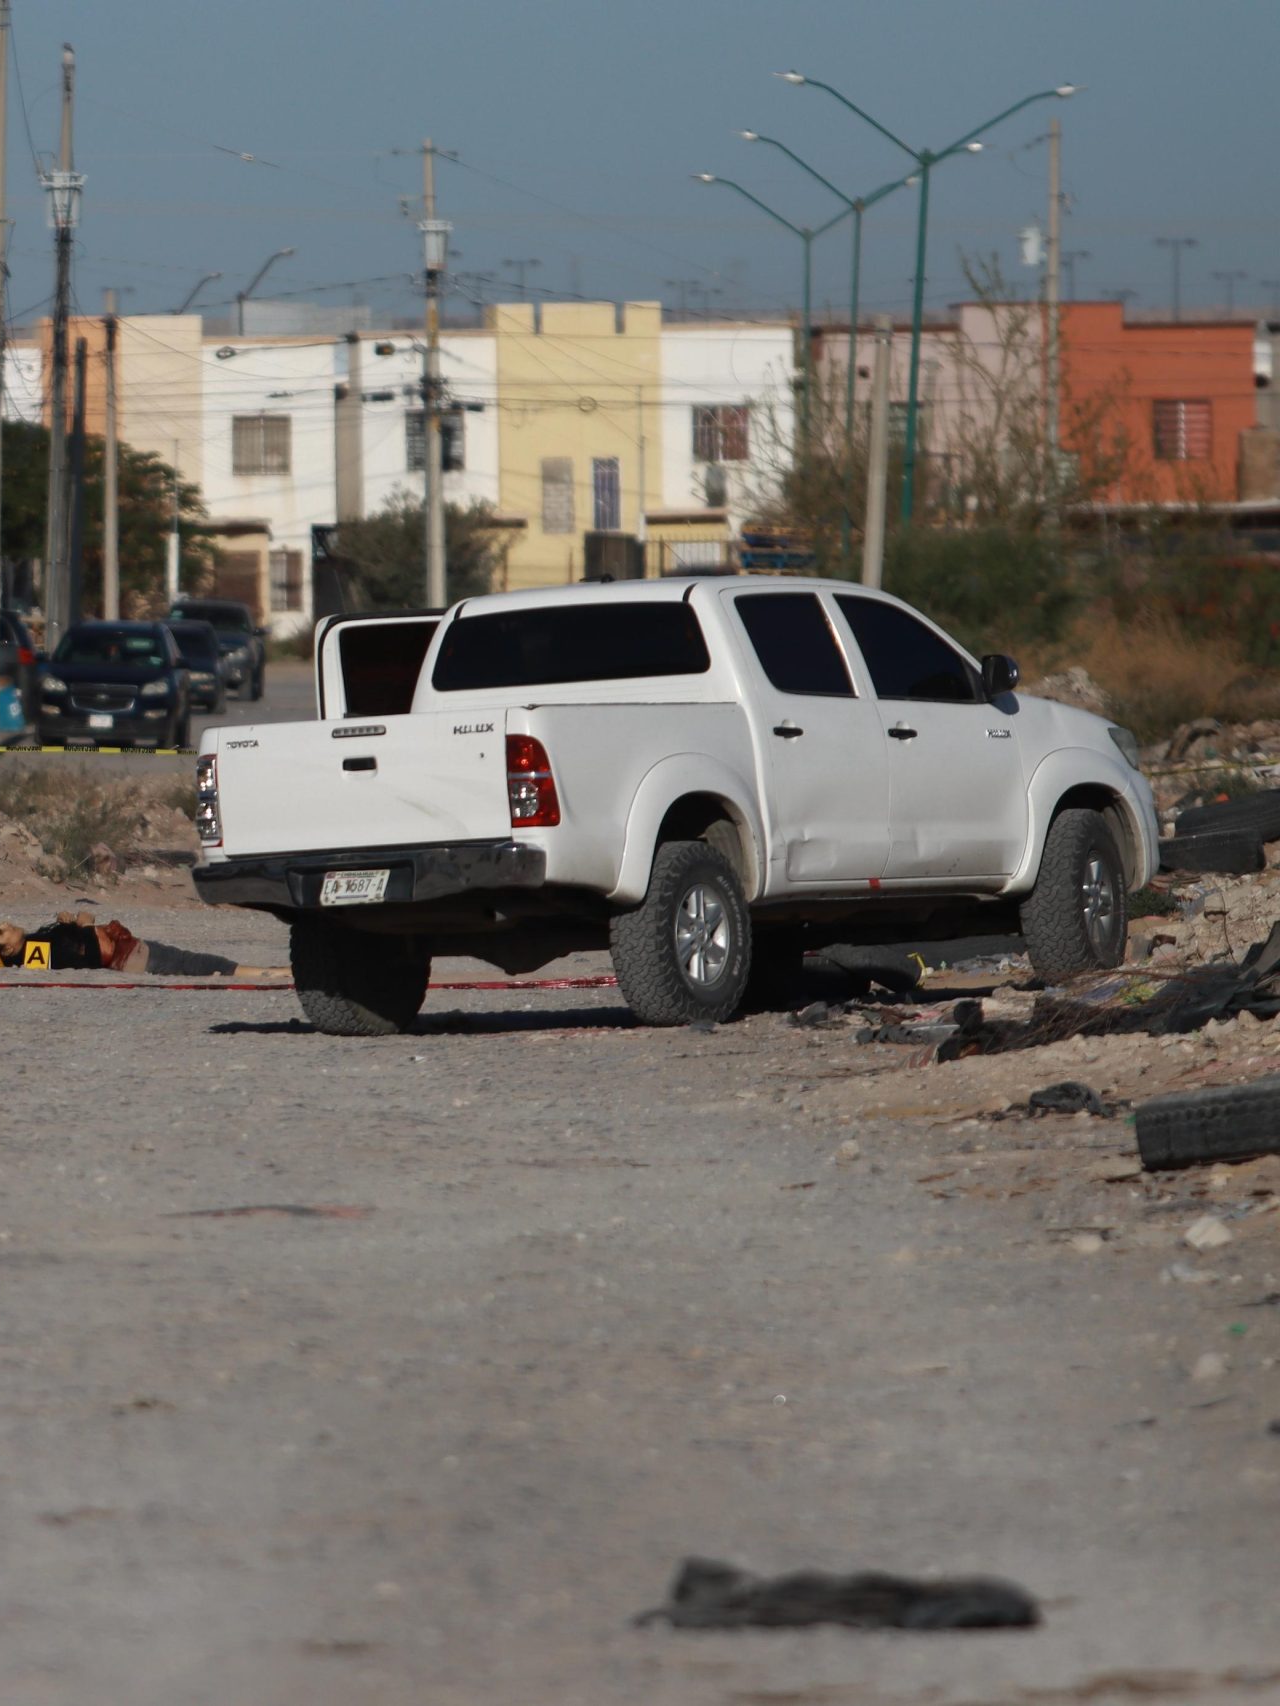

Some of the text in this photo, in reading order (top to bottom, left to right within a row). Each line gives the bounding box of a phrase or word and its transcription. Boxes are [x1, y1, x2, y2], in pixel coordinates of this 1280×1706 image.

[453, 723, 494, 734] HILUX
[227, 740, 259, 749] TOYOTA
[27, 946, 45, 964] A
